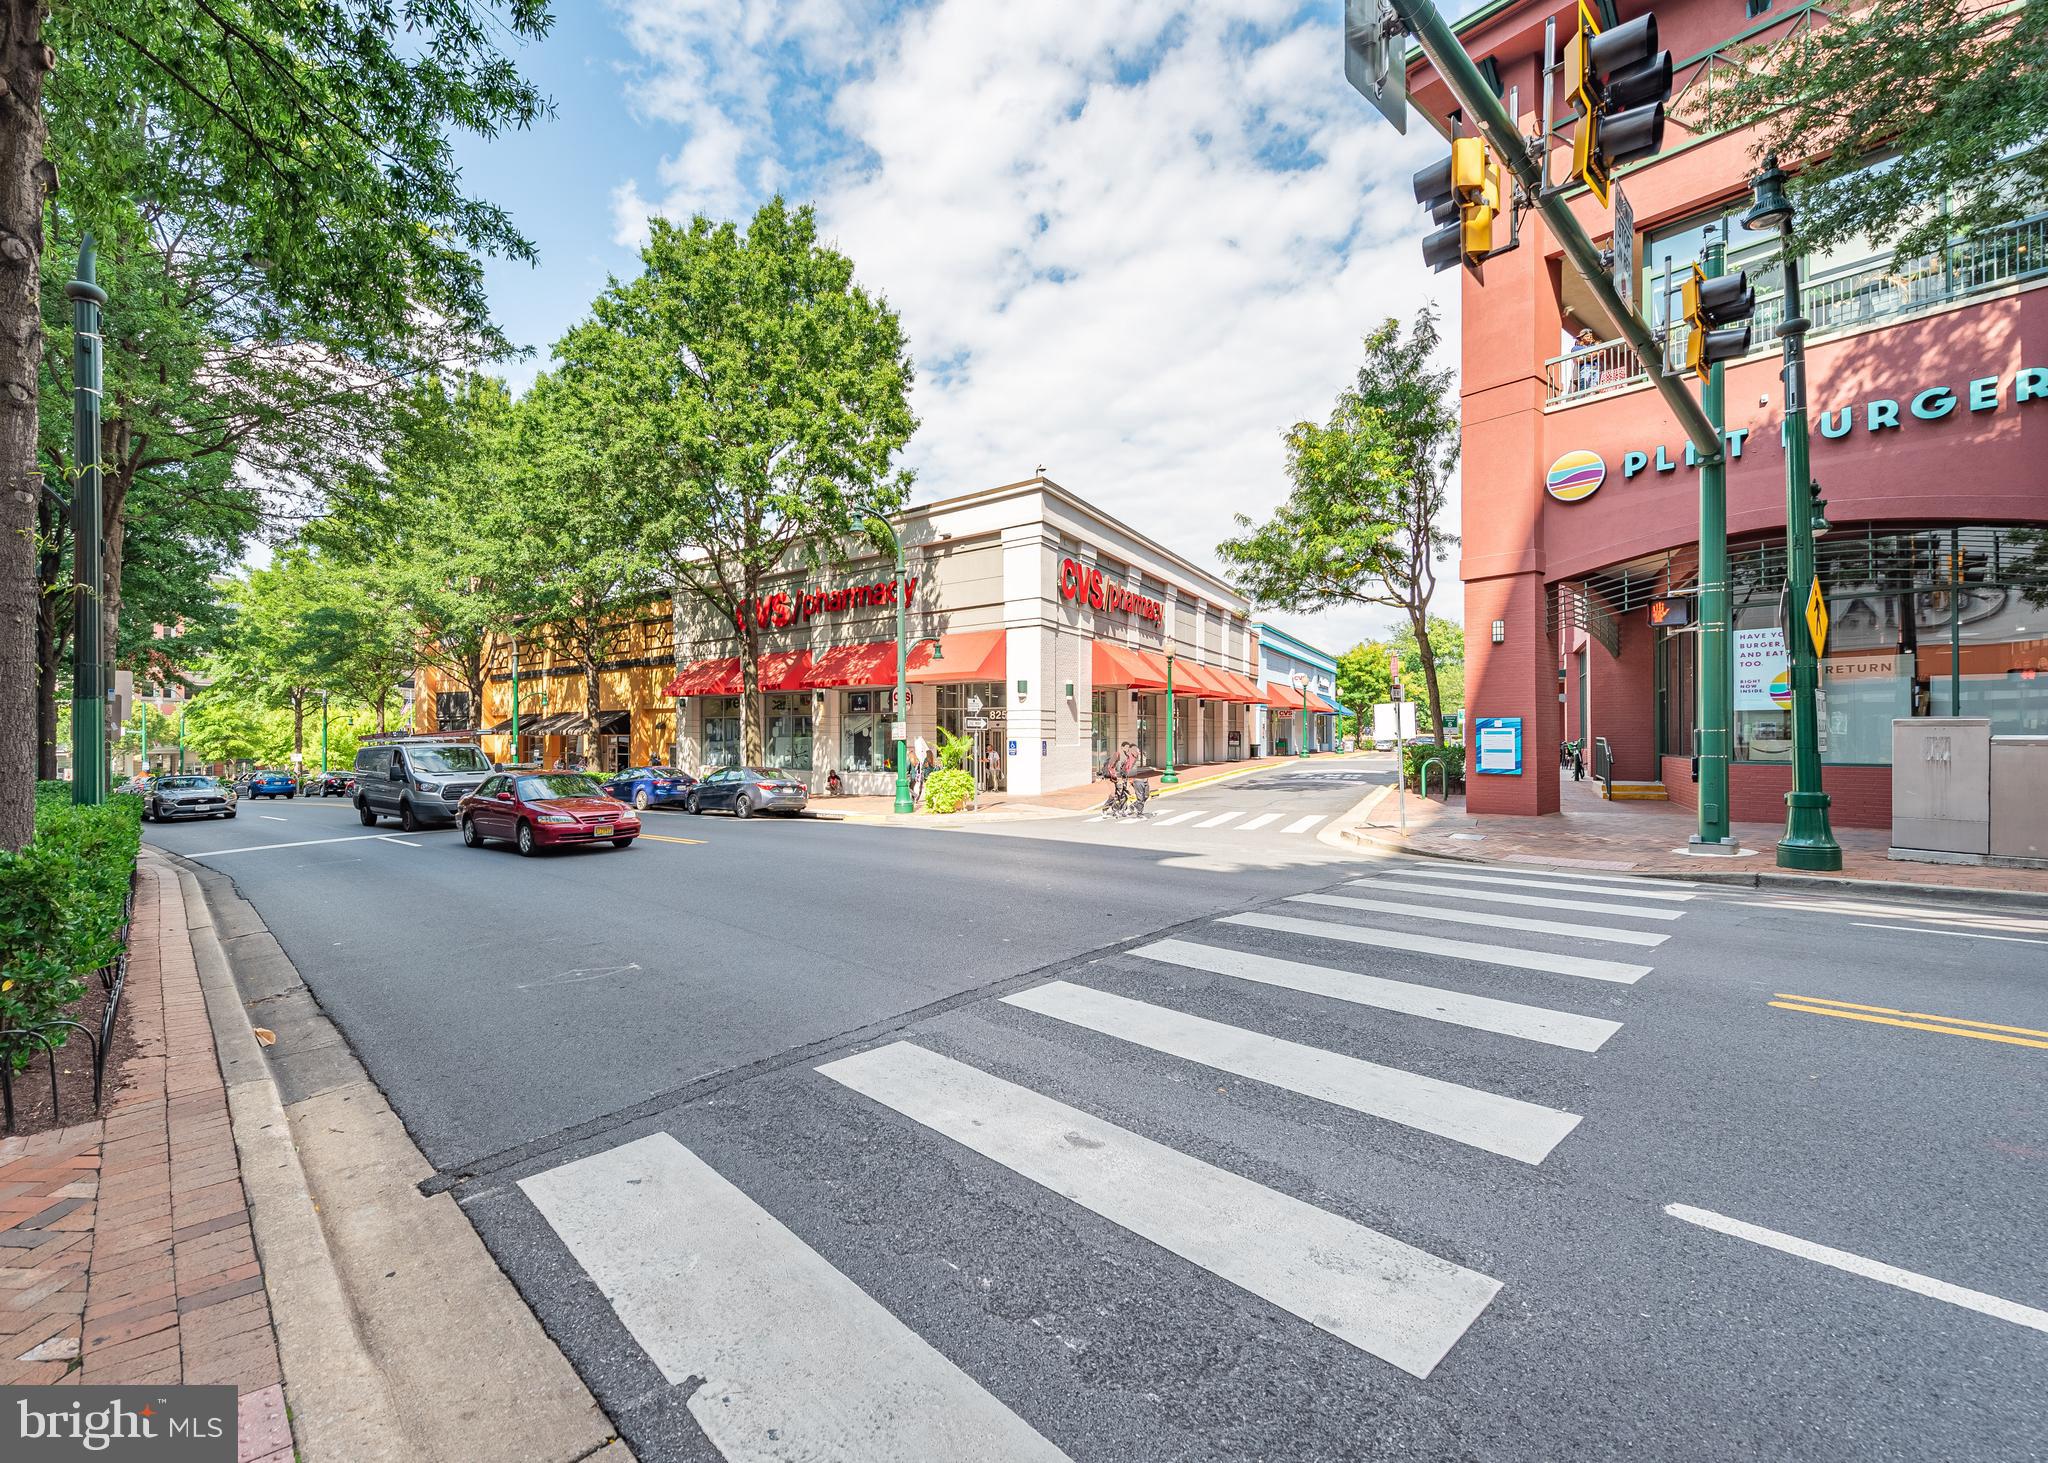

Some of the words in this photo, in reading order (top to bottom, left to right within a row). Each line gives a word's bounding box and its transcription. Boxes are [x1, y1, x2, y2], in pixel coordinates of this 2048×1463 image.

[1780, 367, 2048, 449] URGER
[1739, 641, 1785, 649] BURGER,
[1825, 663, 1893, 674] RETURN
[893, 692, 911, 702] CS
[989, 710, 1007, 720] 825
